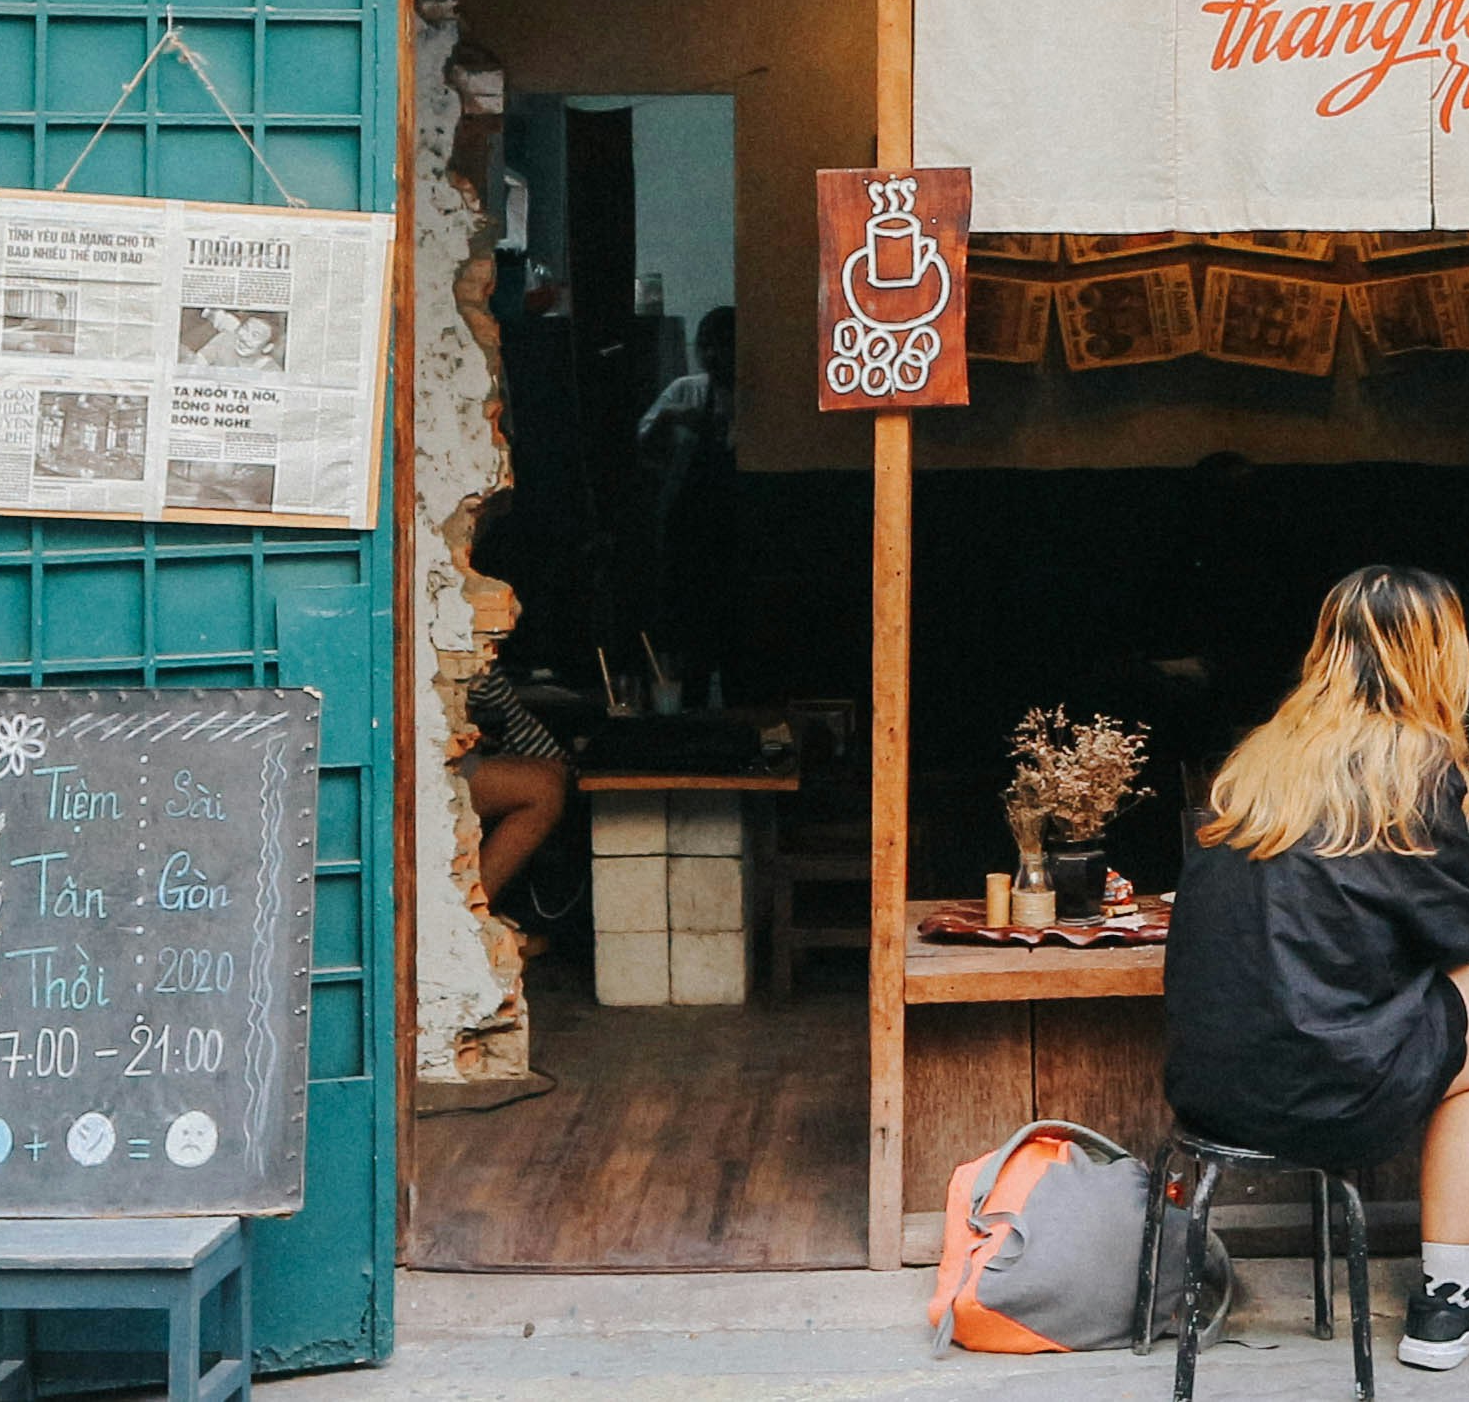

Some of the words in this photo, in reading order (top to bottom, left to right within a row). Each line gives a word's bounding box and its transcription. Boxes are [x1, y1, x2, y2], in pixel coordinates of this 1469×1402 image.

[33, 765, 124, 833] Tiệm
[165, 769, 227, 820] Sài
[10, 852, 108, 919] Tân
[157, 851, 233, 911] Gòn
[4, 942, 110, 1010] Thời
[154, 947, 236, 994] 2020
[123, 1023, 225, 1078] 21:00
